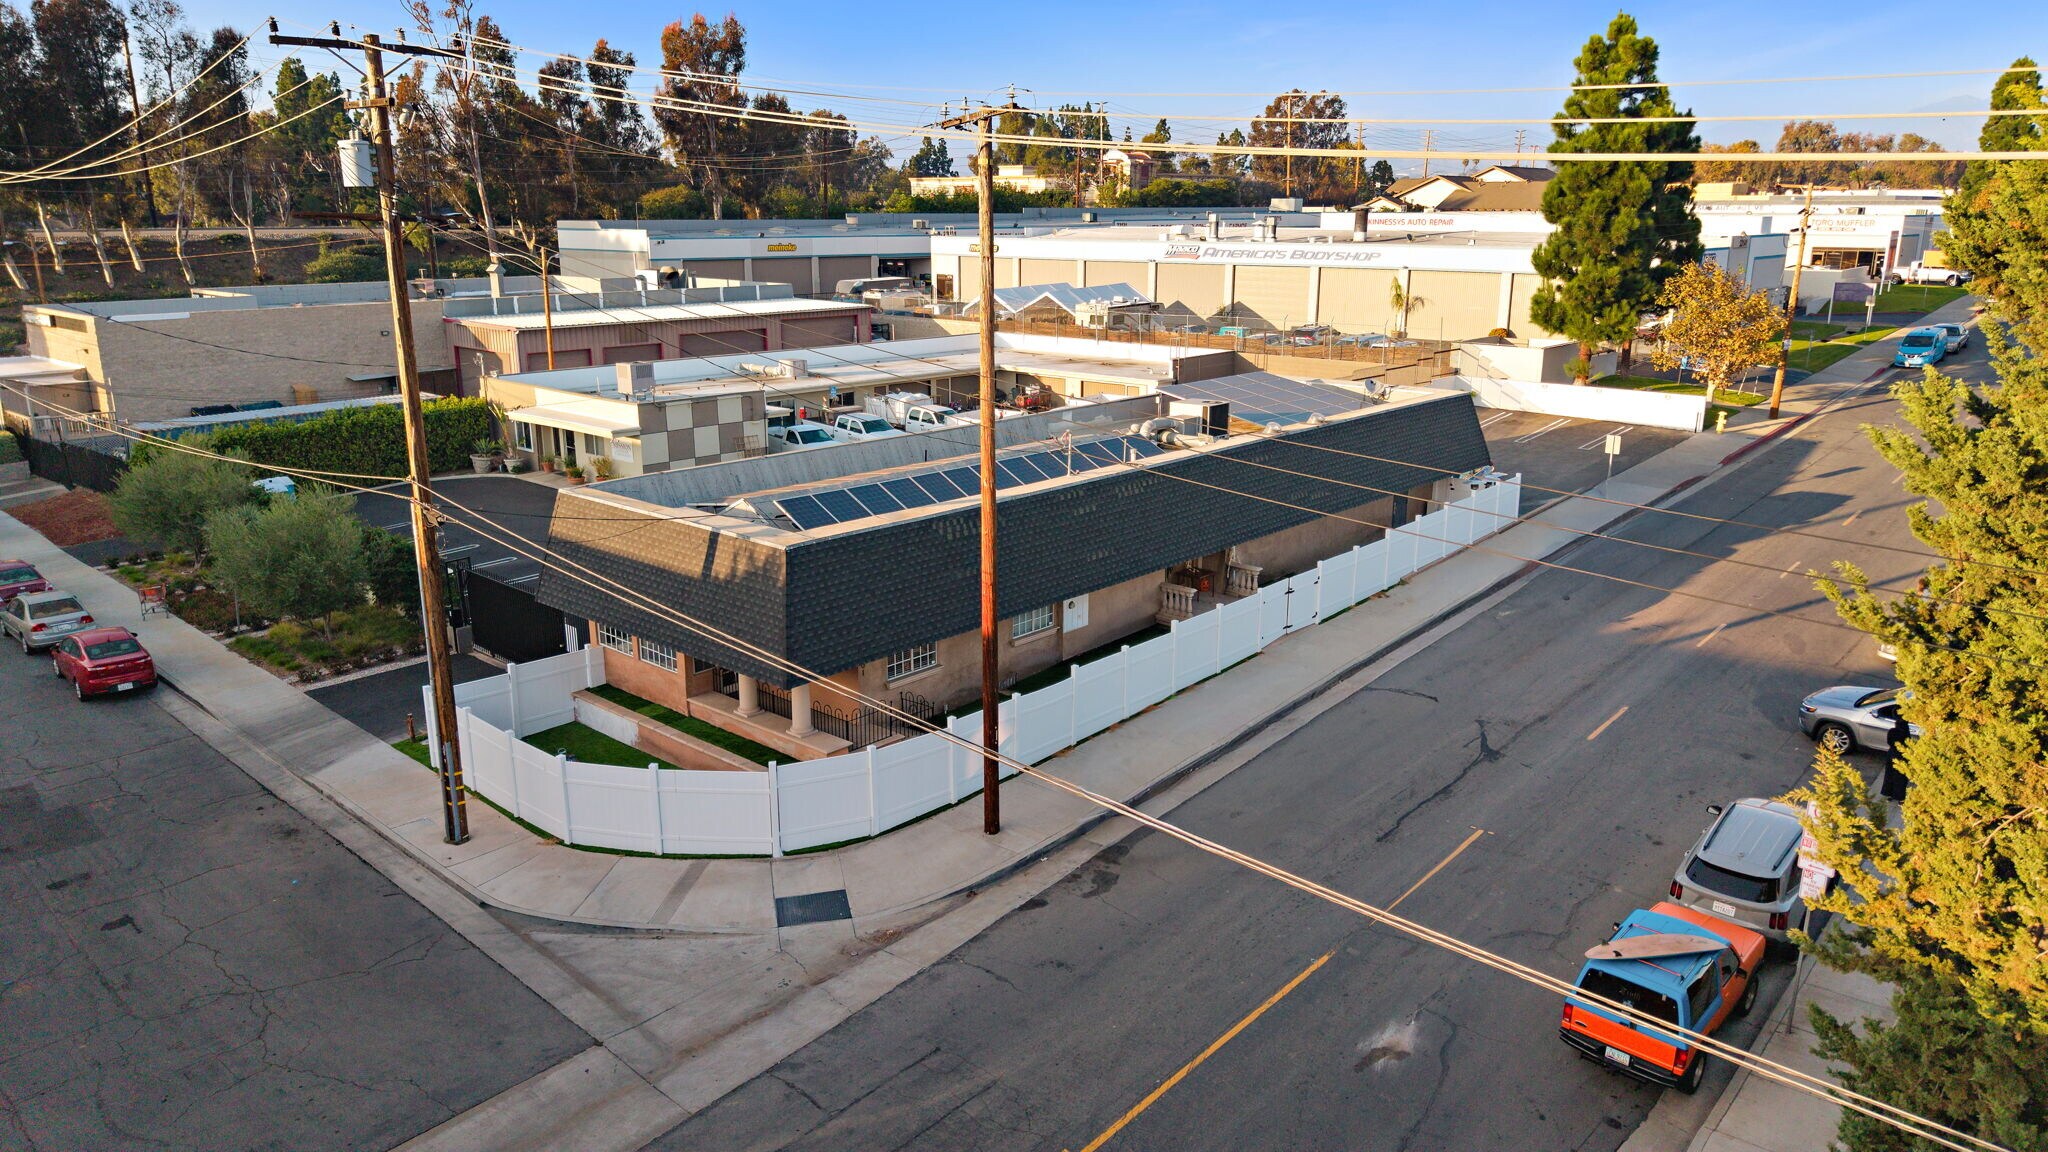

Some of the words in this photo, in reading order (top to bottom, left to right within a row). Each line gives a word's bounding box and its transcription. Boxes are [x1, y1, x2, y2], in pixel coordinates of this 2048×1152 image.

[1407, 218, 1427, 226] AUTO
[1429, 218, 1454, 227] REPAIR
[1836, 219, 1876, 227] MUFFLER
